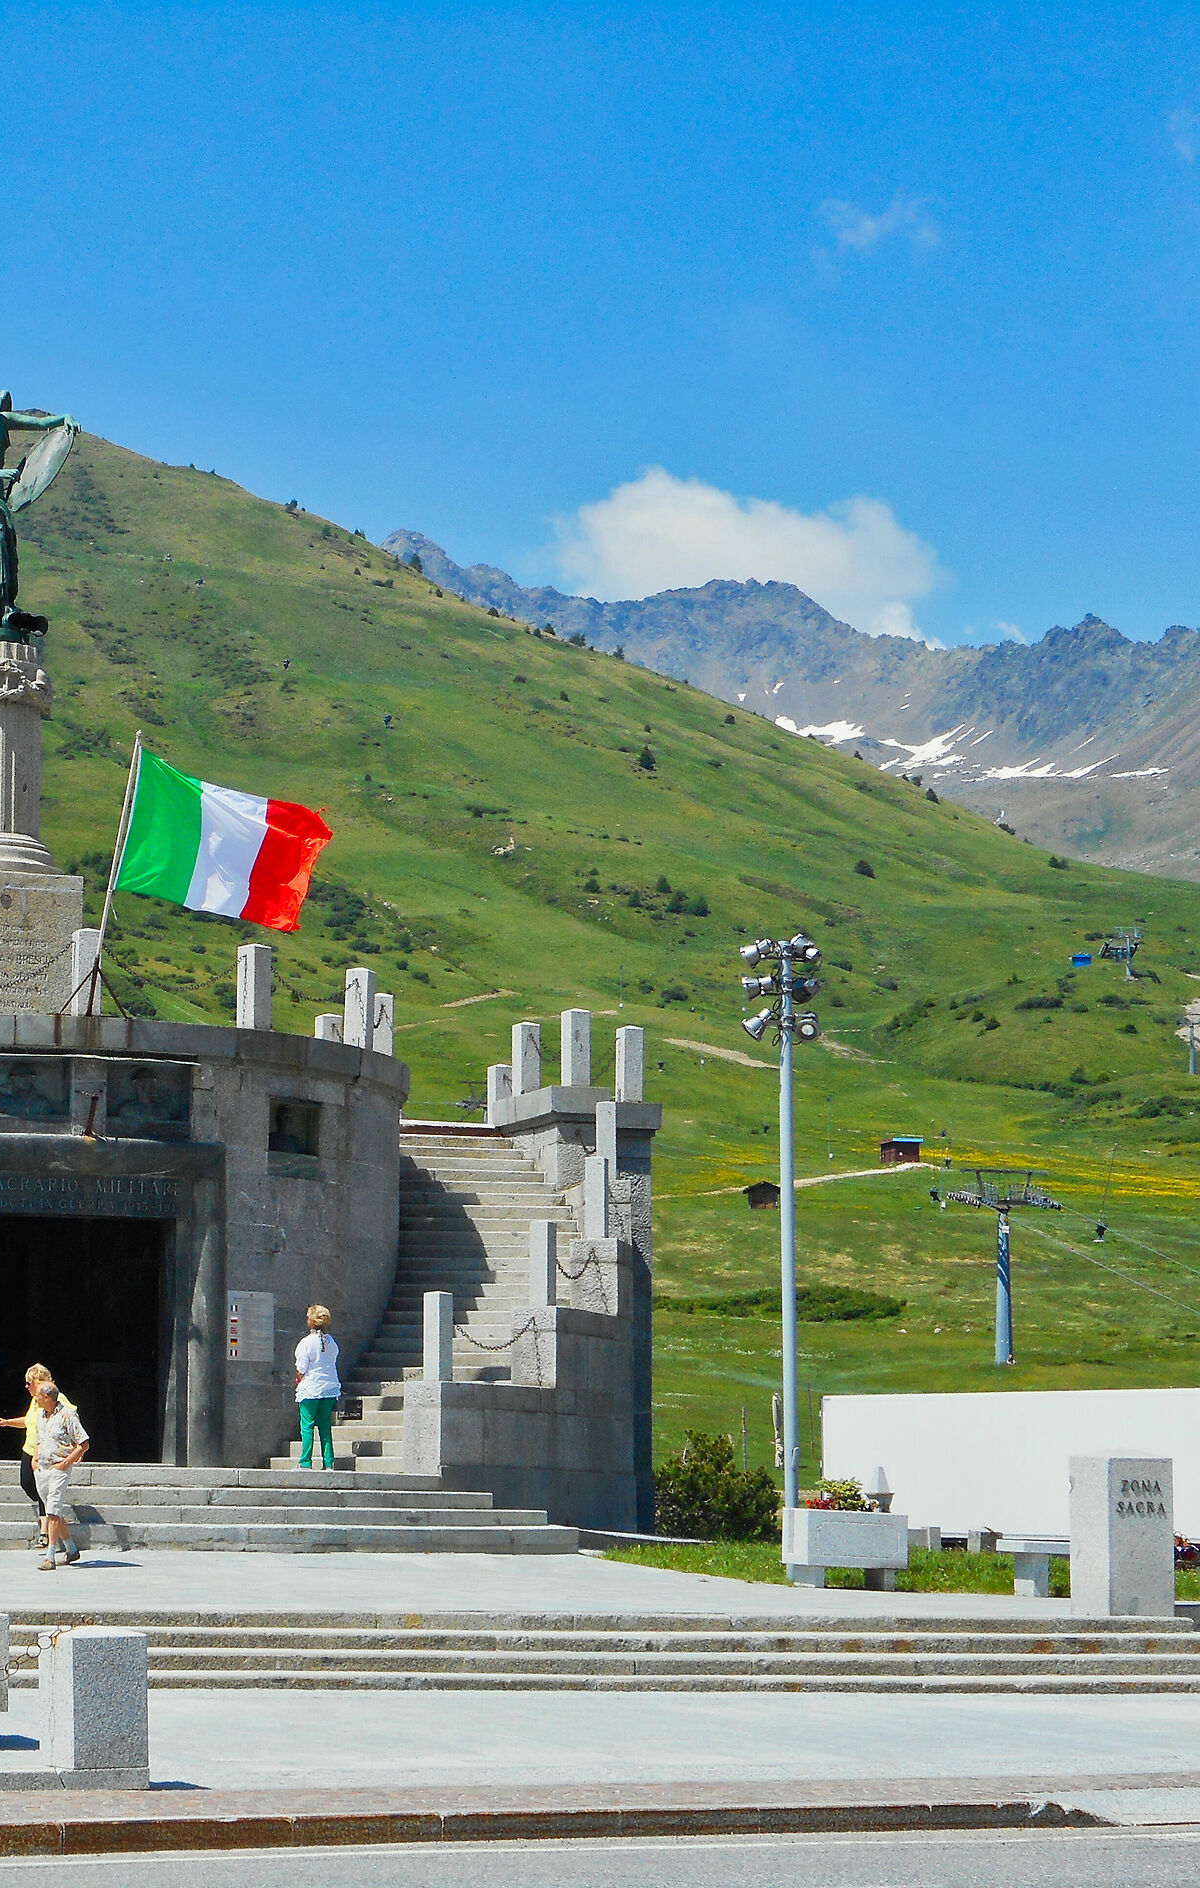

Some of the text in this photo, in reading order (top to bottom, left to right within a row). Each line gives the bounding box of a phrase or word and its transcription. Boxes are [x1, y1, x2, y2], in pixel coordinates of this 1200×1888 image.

[96, 1179, 181, 1195] MILITARE
[1120, 1479, 1163, 1494] ZONA
[1116, 1501, 1167, 1515] SACRA
